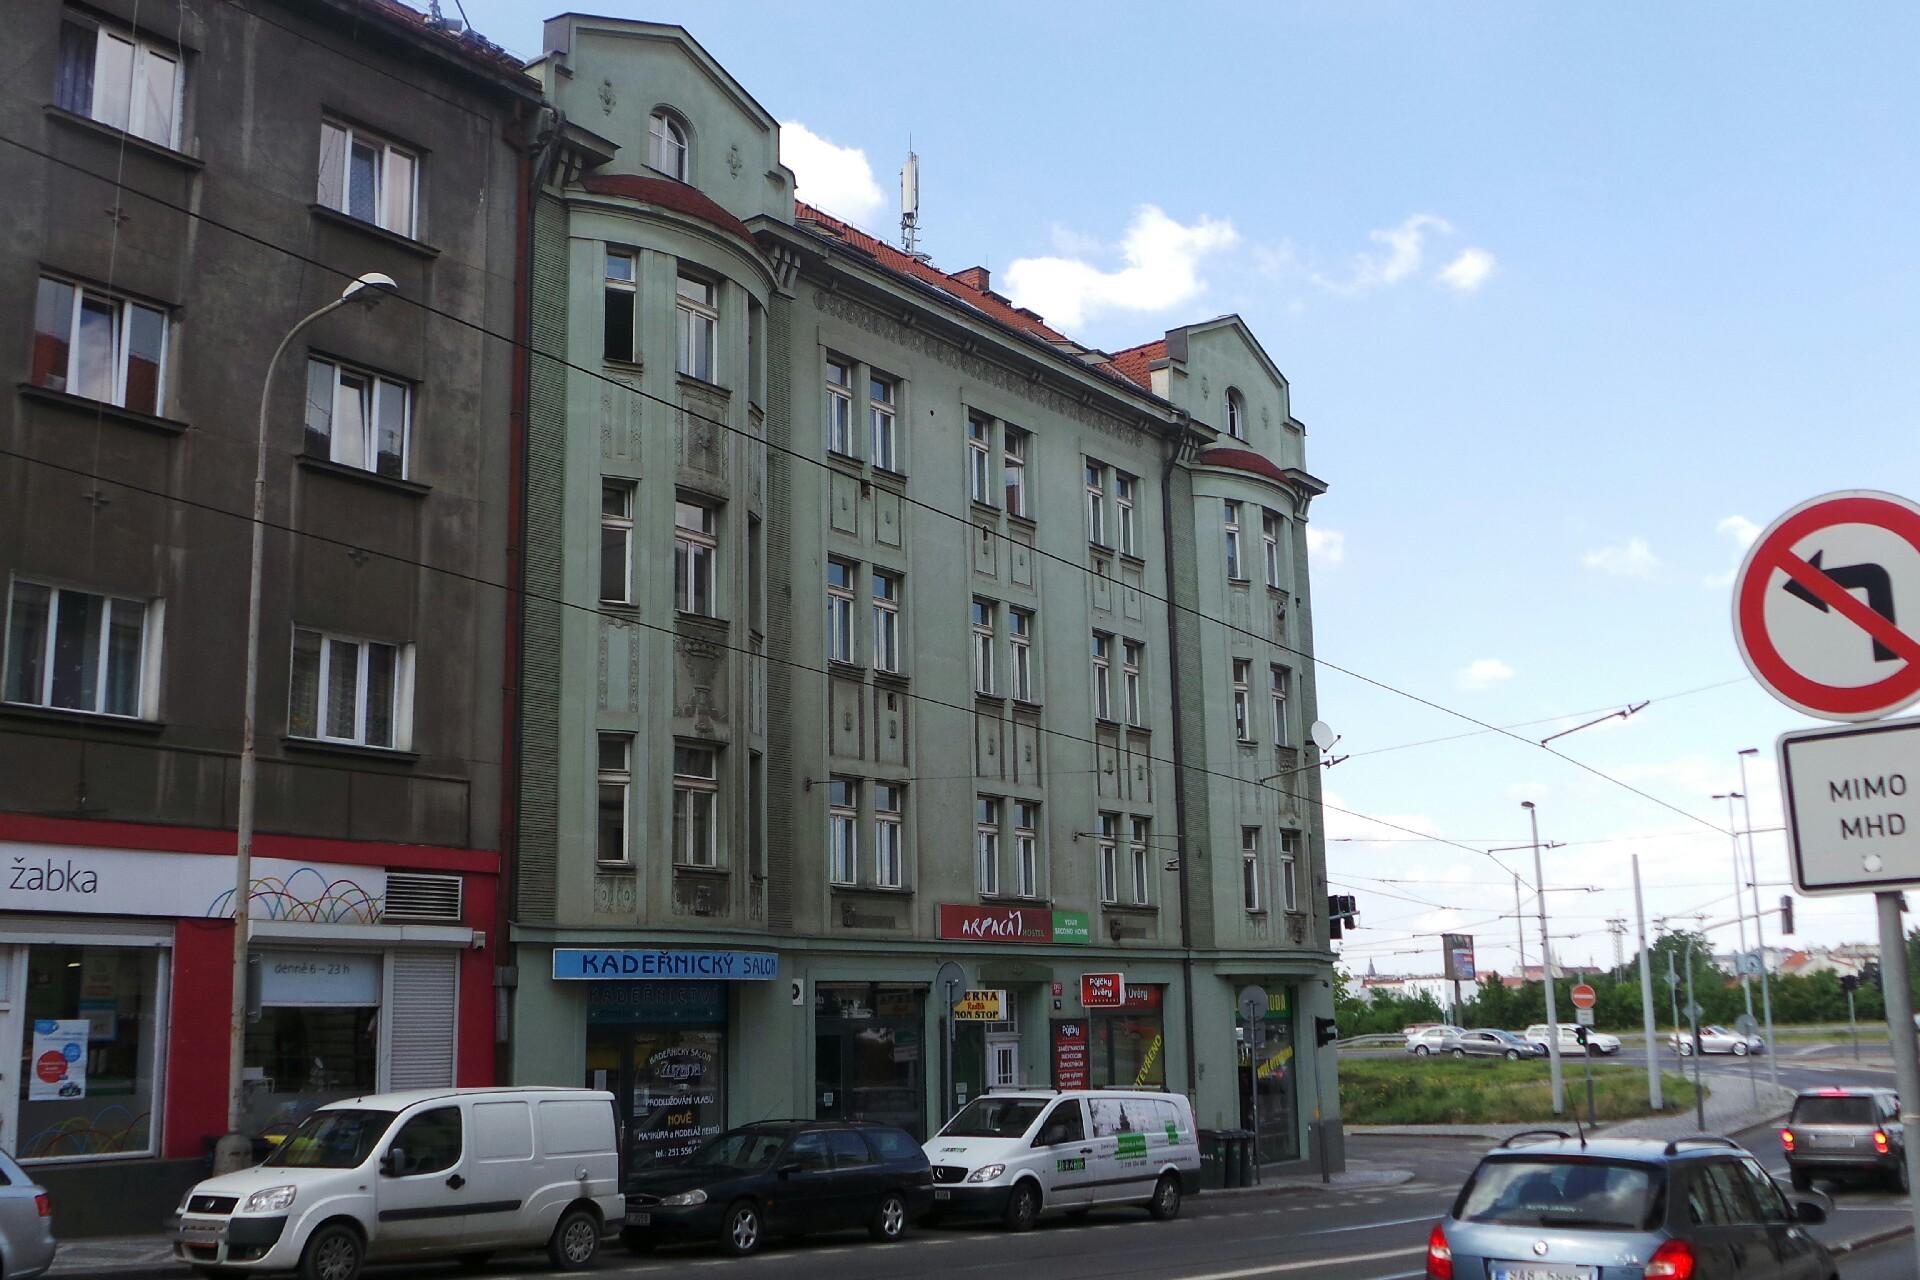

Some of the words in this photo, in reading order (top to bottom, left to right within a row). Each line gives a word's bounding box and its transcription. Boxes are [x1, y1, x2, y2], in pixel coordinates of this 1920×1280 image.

[1829, 774, 1906, 803] MIMO
[1840, 813, 1905, 840] MHD
[9, 856, 98, 893] žabka
[1055, 927, 1073, 935] SECOND
[328, 963, 341, 975] 23
[343, 962, 350, 974] h
[582, 951, 734, 974] KADEŘNICKÝ
[743, 957, 776, 975] SALON
[963, 991, 998, 1001] ERNA
[954, 1011, 972, 1019] NON
[975, 1011, 999, 1019] STOP
